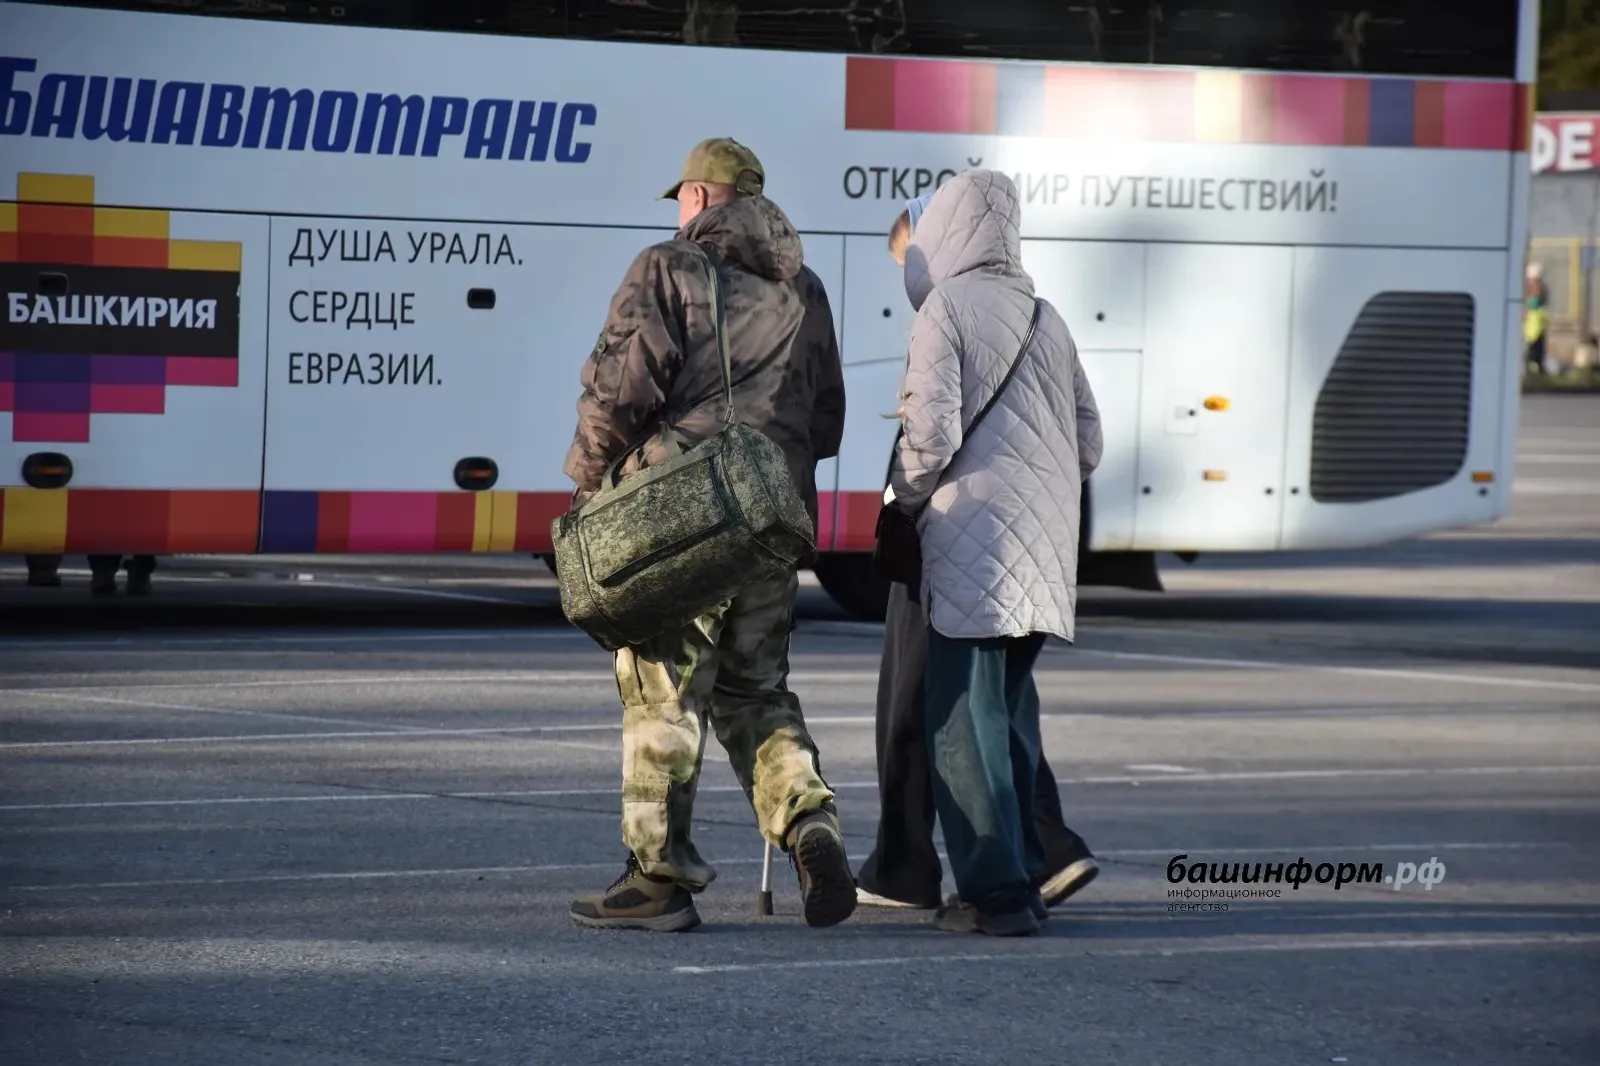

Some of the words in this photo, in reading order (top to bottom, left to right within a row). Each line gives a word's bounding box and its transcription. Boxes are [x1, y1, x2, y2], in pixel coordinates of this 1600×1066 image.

[1081, 168, 1338, 212] ПУТЕШЕСТВИЙ!
[288, 229, 396, 267] ДУША
[407, 231, 524, 265] УРАЛА.
[8, 292, 217, 329] БАШКИРИЯ
[288, 289, 416, 330] СЕРДЦЕ
[288, 353, 443, 386] ЕВРАЗИИ.
